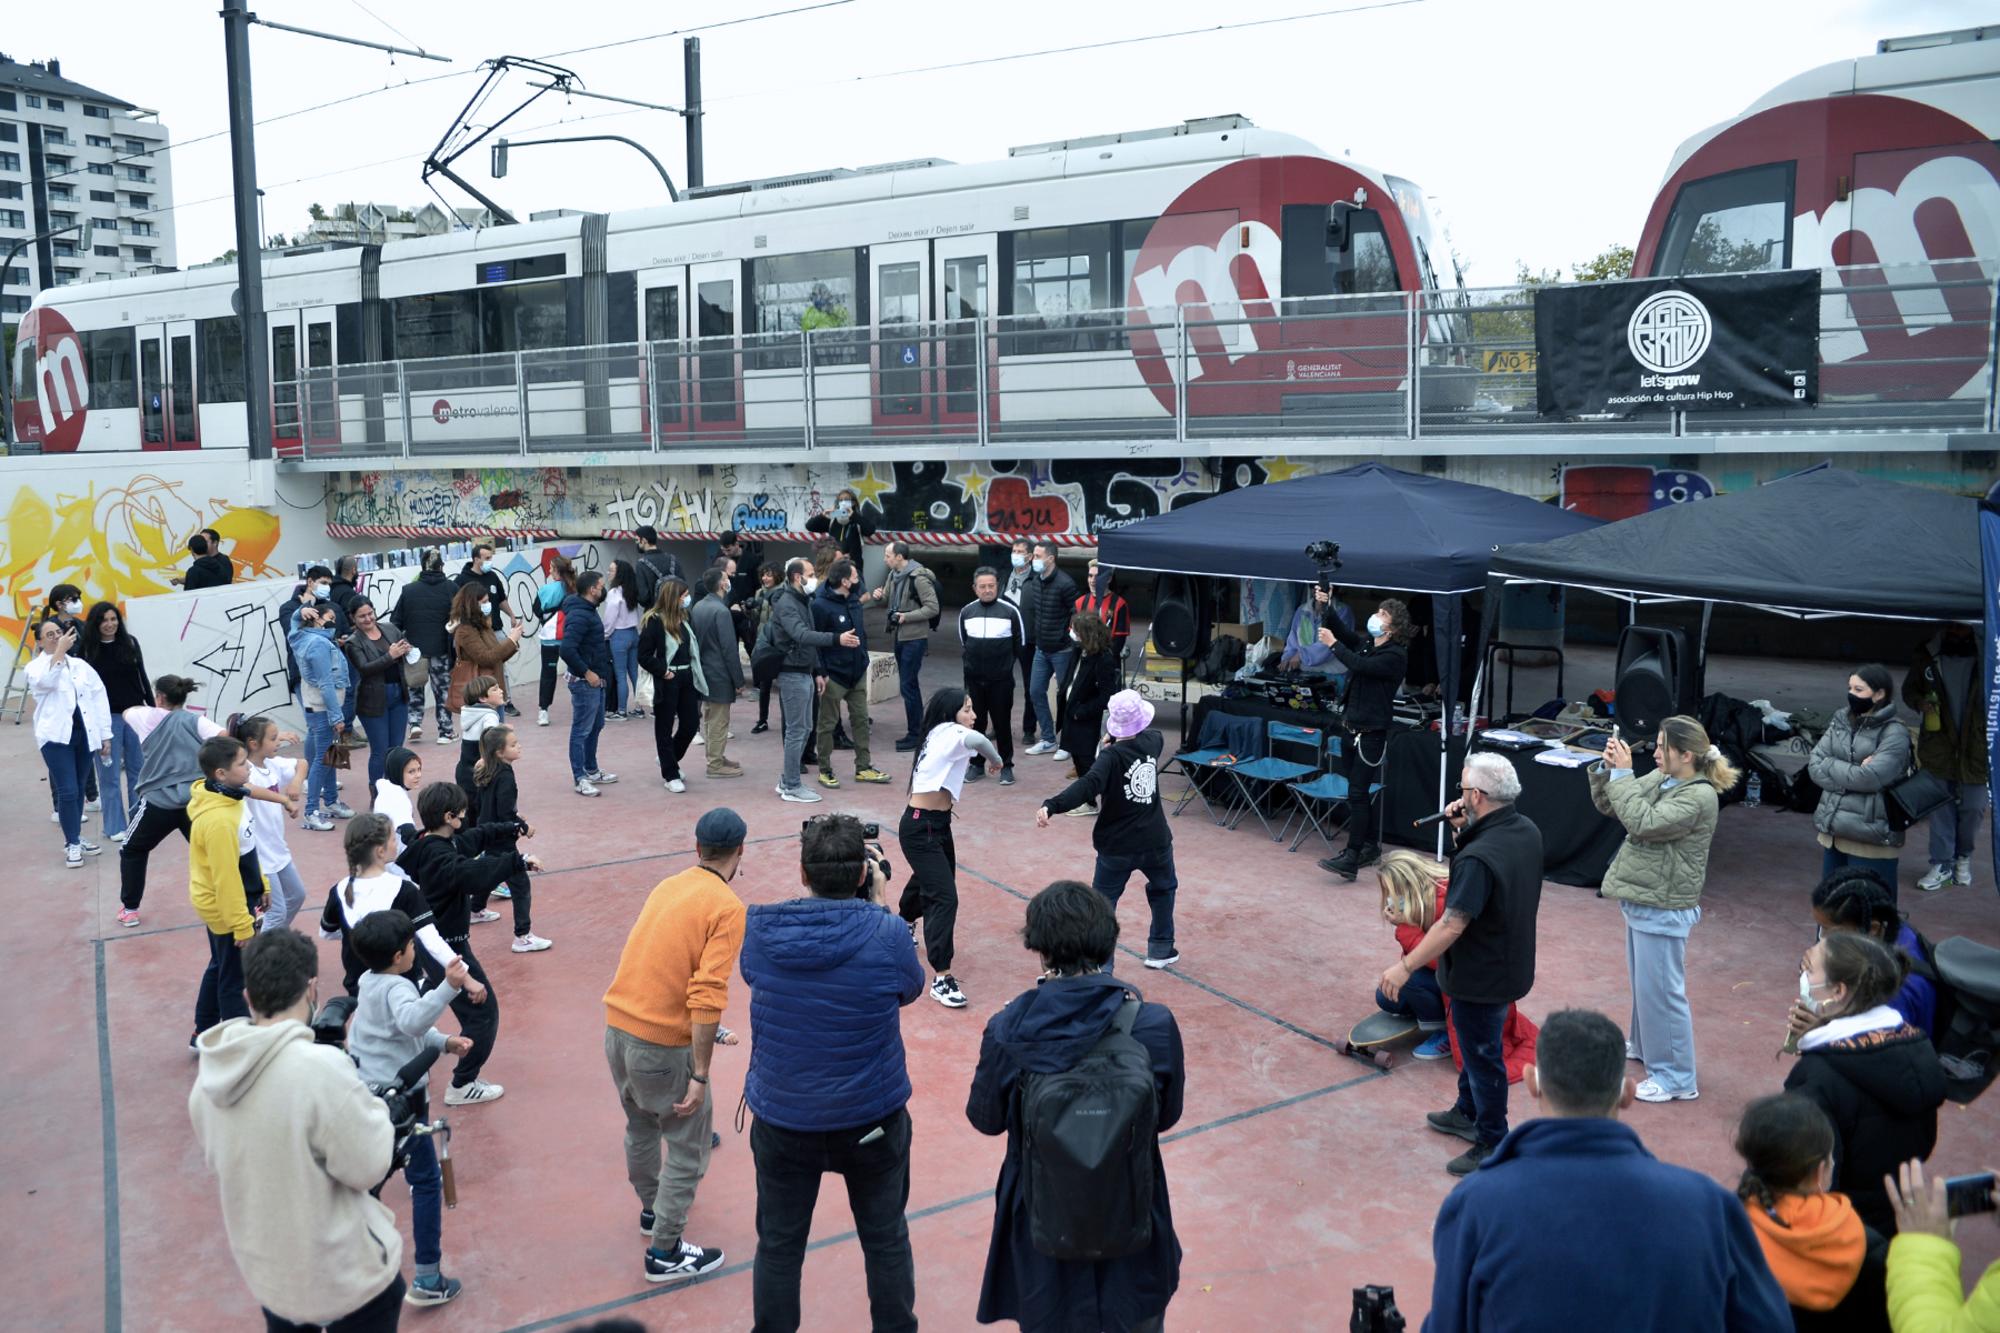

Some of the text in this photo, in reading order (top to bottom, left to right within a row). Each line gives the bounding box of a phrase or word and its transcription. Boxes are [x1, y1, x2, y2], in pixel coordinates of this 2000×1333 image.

[1297, 363, 1341, 371] GENERALITAT
[1298, 370, 1341, 378] VALENCIANA
[1640, 374, 1701, 390] let'sgrow
[1607, 390, 1734, 404] asociación de cultura Hip Hop
[439, 403, 521, 420] metrovalenci
